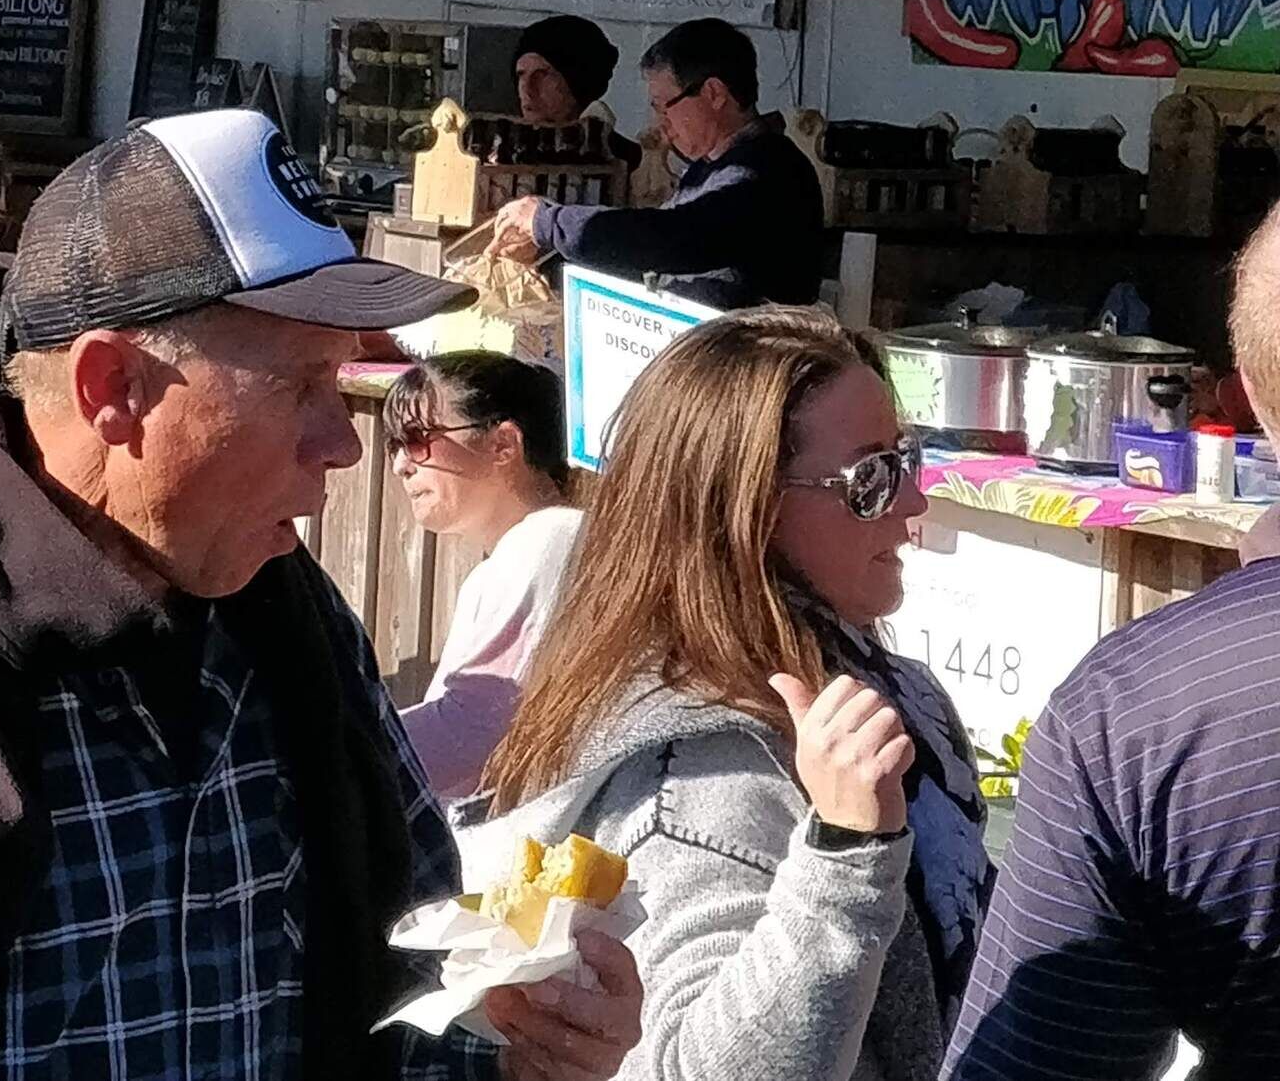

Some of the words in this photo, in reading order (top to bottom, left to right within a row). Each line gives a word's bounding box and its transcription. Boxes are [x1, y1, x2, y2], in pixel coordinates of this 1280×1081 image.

[587, 297, 663, 335] DISCOVER
[605, 332, 662, 359] DISCOV
[920, 628, 1021, 696] 1448
